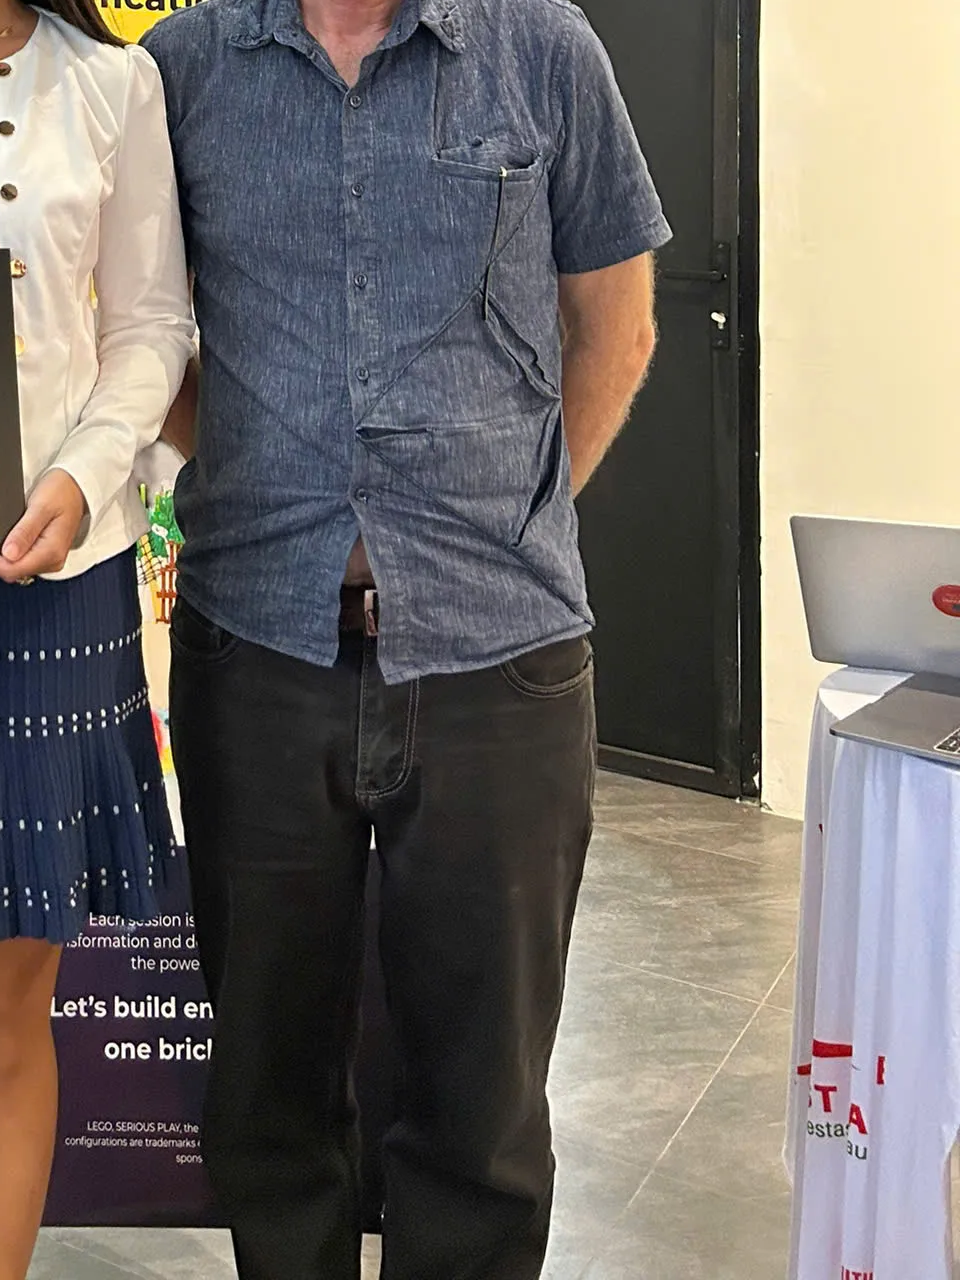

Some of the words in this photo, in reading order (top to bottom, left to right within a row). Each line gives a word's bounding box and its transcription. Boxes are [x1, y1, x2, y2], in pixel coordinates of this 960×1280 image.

[66, 933, 150, 949] sformation
[153, 934, 182, 949] and
[185, 934, 199, 949] d
[131, 955, 156, 971] the
[159, 958, 201, 974] powe
[114, 995, 177, 1019] build
[183, 1000, 214, 1019] en
[104, 1041, 152, 1060] one
[116, 1121, 156, 1133] SERIOUS
[157, 1122, 183, 1134] PLAY,
[183, 1122, 199, 1133] the
[64, 1136, 127, 1148] configurations
[129, 1138, 143, 1147] are
[145, 1138, 197, 1148] trademarks
